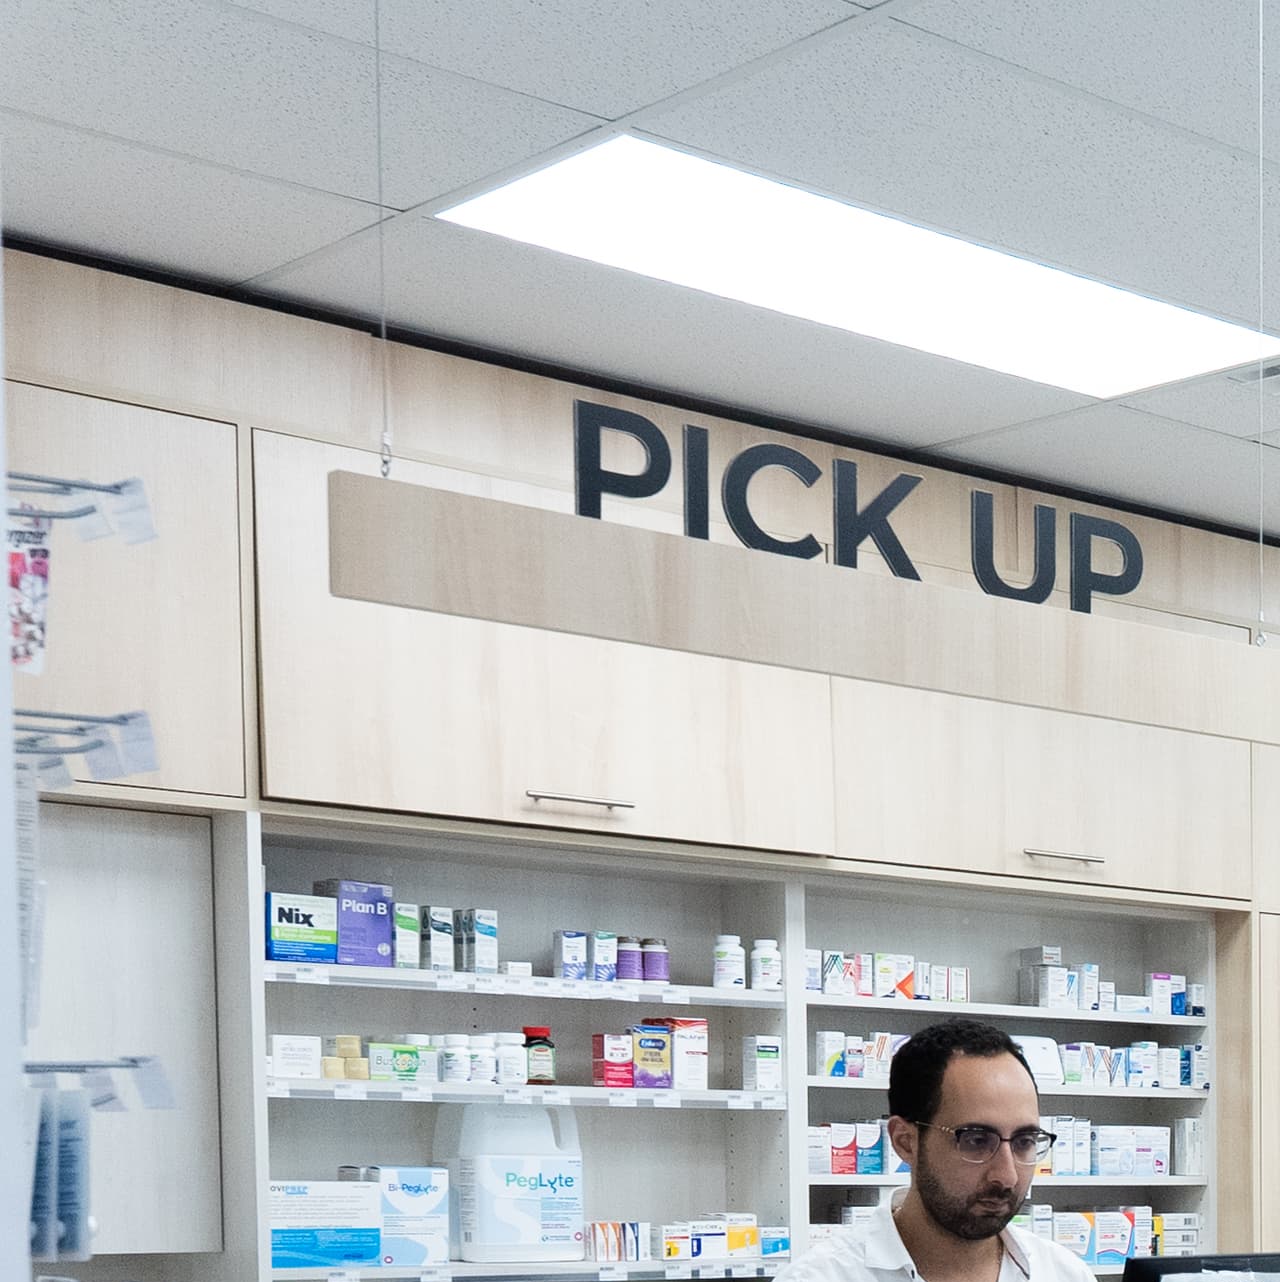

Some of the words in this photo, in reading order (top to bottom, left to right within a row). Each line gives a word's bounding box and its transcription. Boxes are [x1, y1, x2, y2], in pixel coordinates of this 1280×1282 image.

[574, 400, 924, 582] PICK
[971, 489, 1144, 614] UP
[277, 906, 314, 928] Nix
[341, 898, 375, 915] Plan
[376, 902, 388, 916] B
[376, 1054, 427, 1068] Buscopan
[388, 1182, 439, 1195] Bi-PegLyte
[505, 1172, 575, 1194] PegLyte
